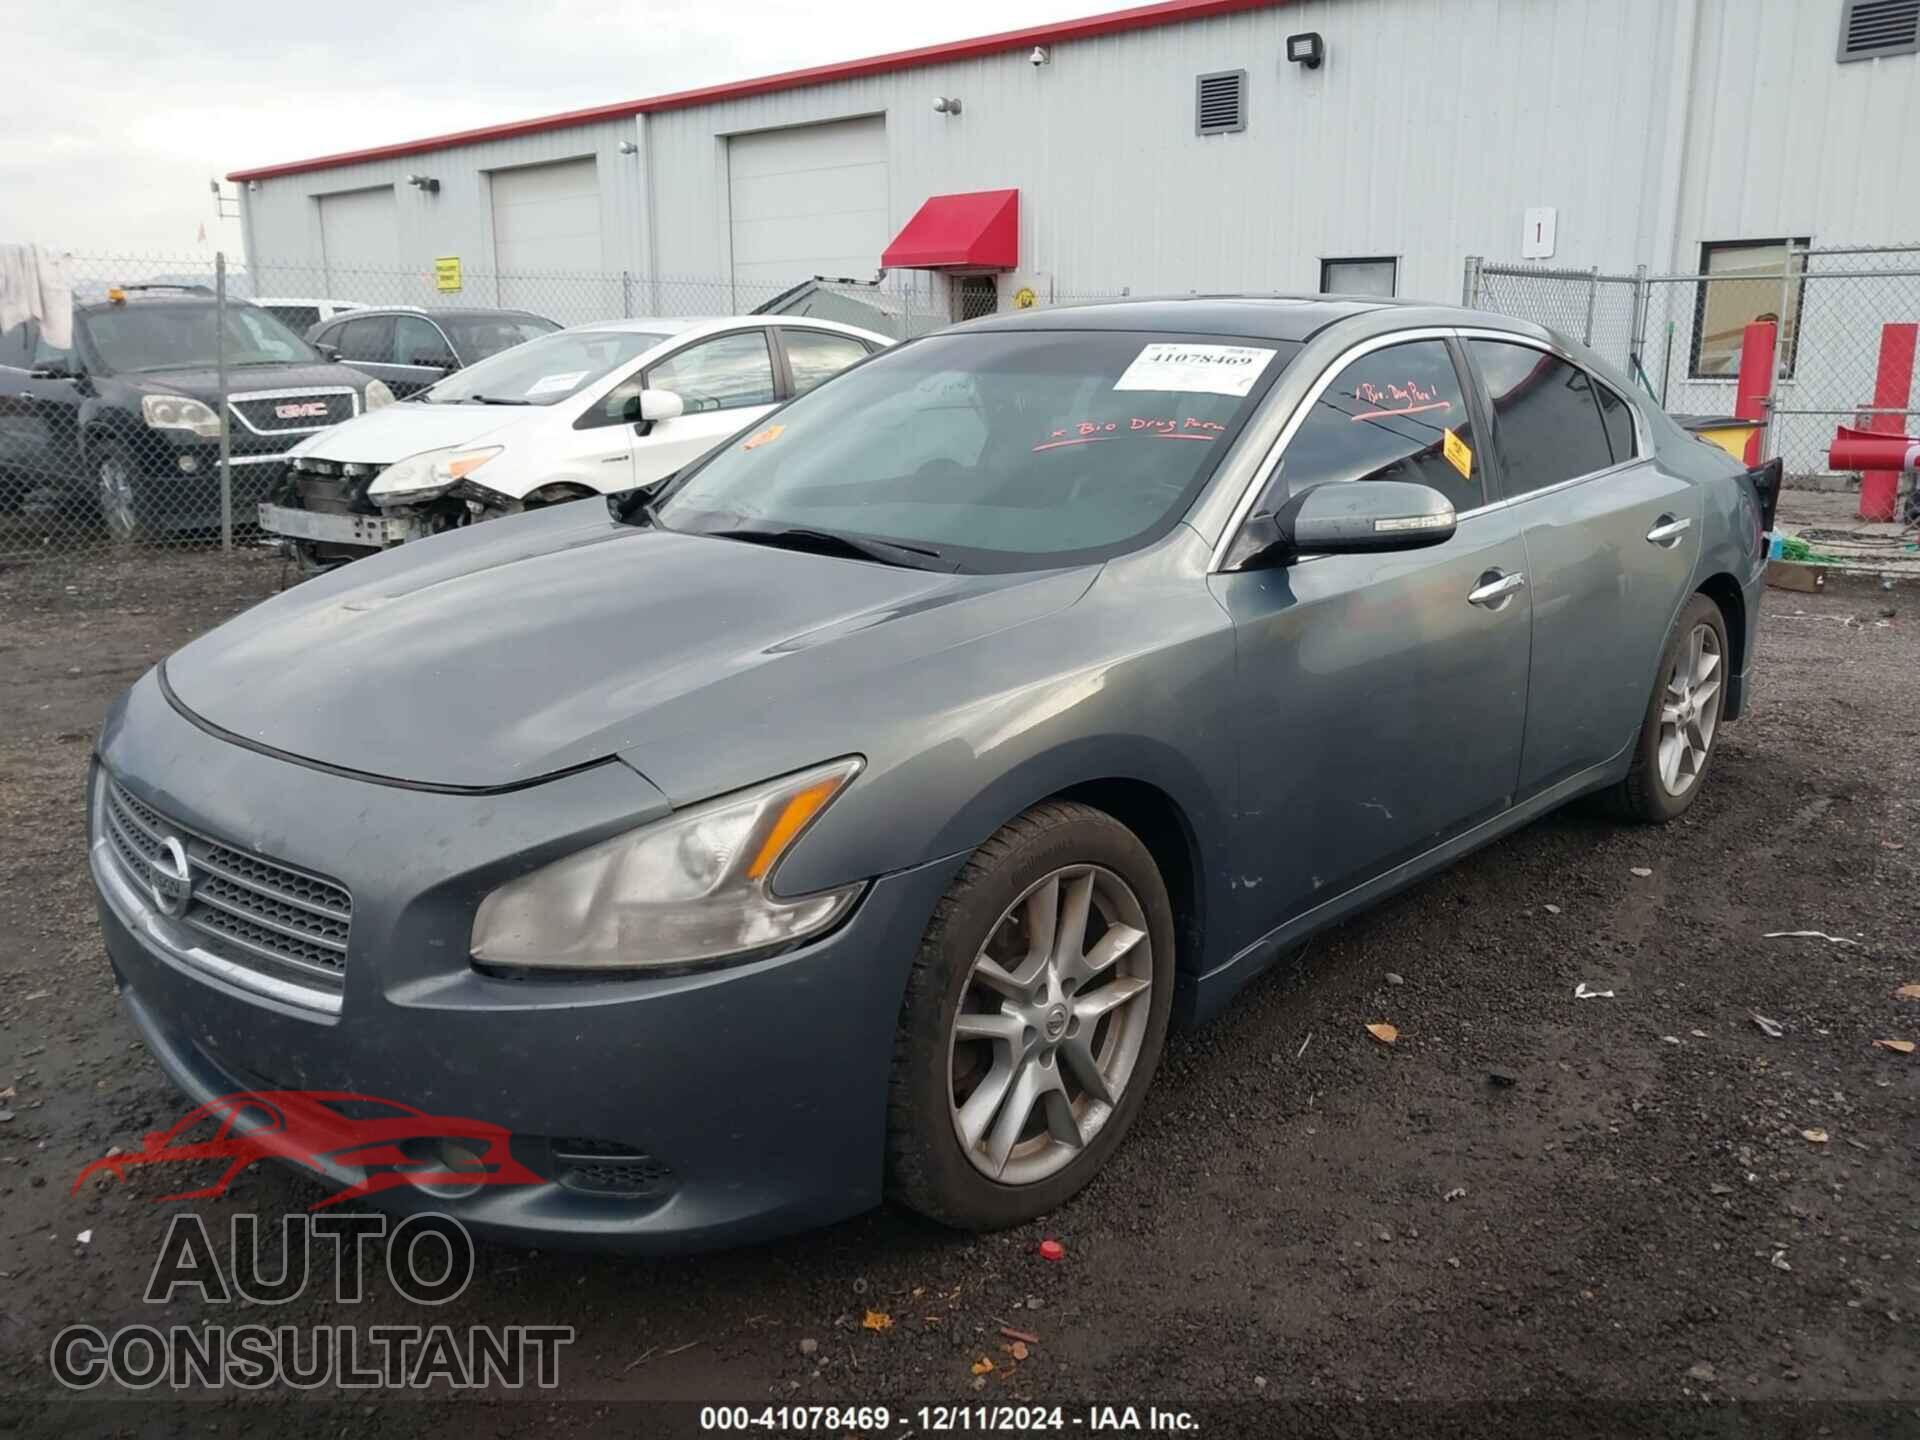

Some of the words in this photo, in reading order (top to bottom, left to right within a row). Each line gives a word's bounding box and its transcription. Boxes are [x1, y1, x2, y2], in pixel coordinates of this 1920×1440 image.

[1148, 352, 1253, 366] 41078469
[275, 402, 328, 418] GMC
[1076, 420, 1117, 435] Bio
[1129, 417, 1177, 433] Drug
